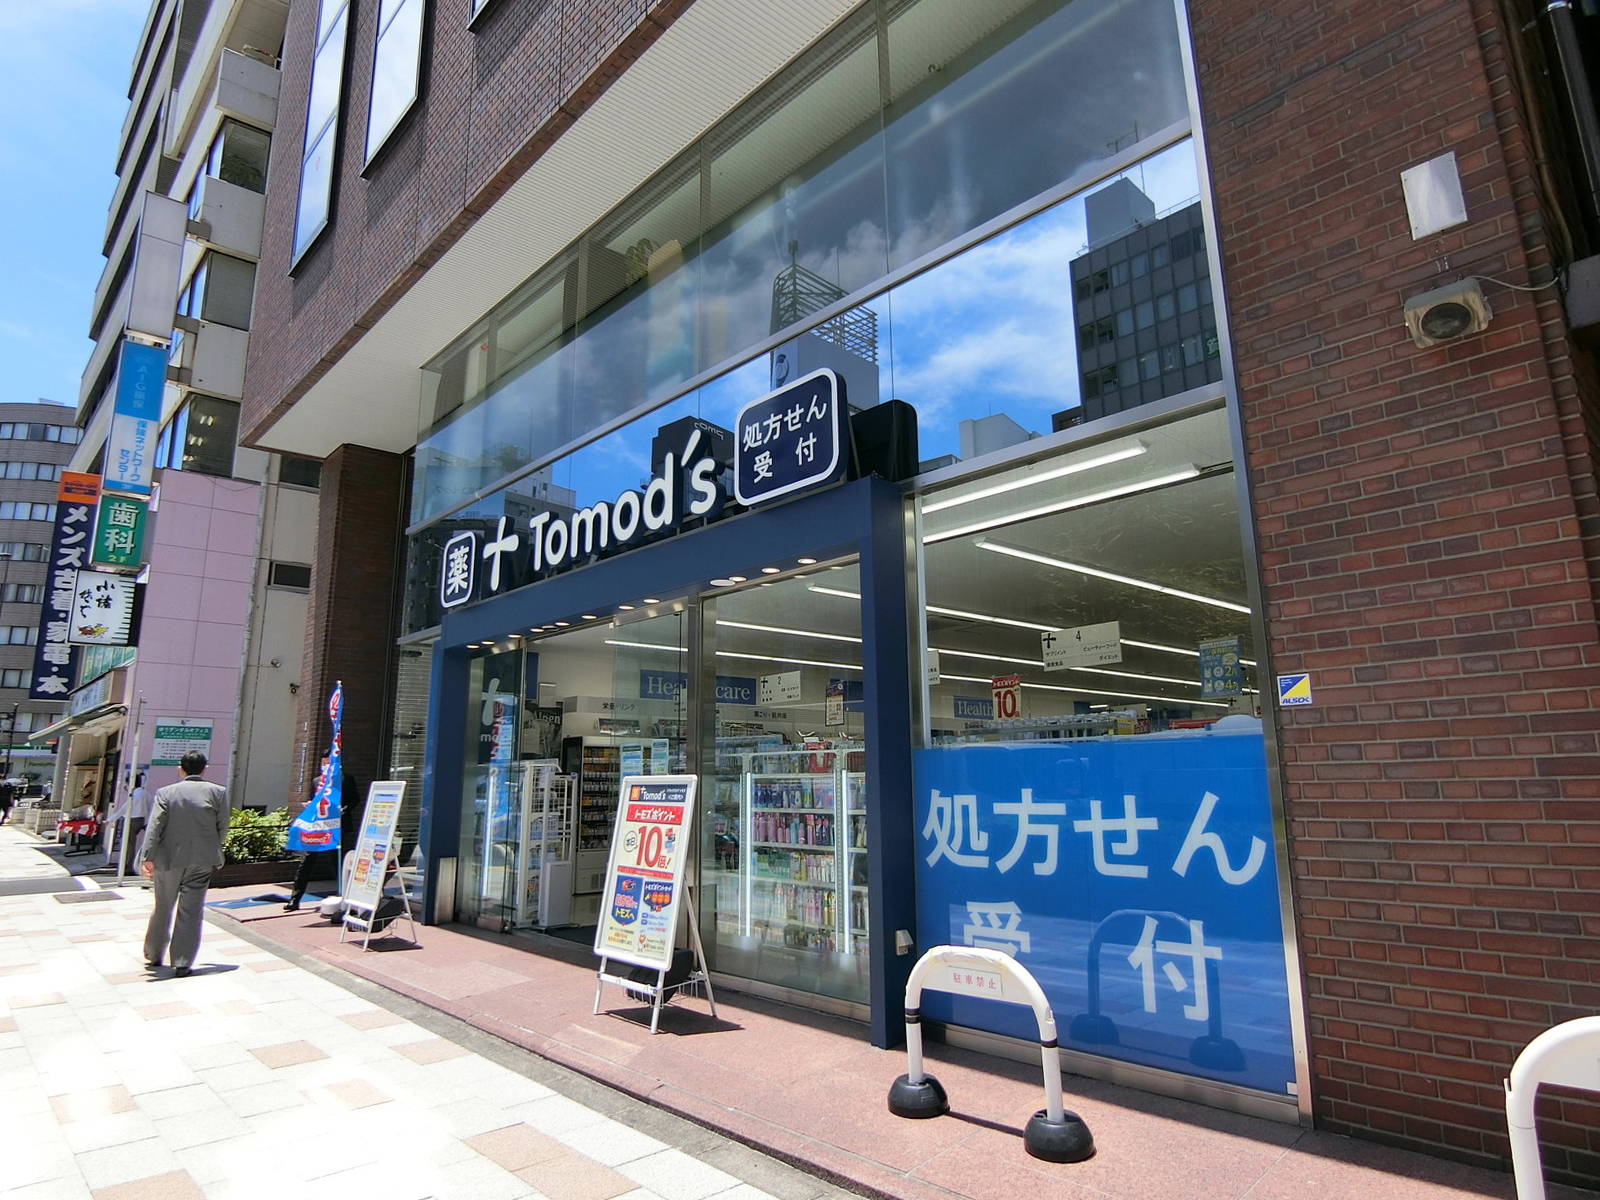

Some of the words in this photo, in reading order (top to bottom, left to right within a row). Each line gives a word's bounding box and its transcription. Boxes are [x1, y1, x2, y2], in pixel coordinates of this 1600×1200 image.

[742, 394, 828, 453] 処方せん
[119, 448, 130, 480] センター
[131, 420, 147, 482] 保険ネットワーク
[753, 436, 818, 484] 受付
[529, 429, 717, 572] Tomod's
[104, 502, 139, 554] 歯科
[108, 555, 127, 563] 2F
[446, 546, 469, 596] 薬
[1076, 630, 1081, 641] 4
[994, 689, 1017, 718] 10
[634, 808, 676, 821] トモズポイント
[643, 790, 666, 800] Tomod's
[636, 825, 663, 868] 10
[922, 787, 1267, 886] 処方せん
[953, 972, 997, 989] 駐車禁止
